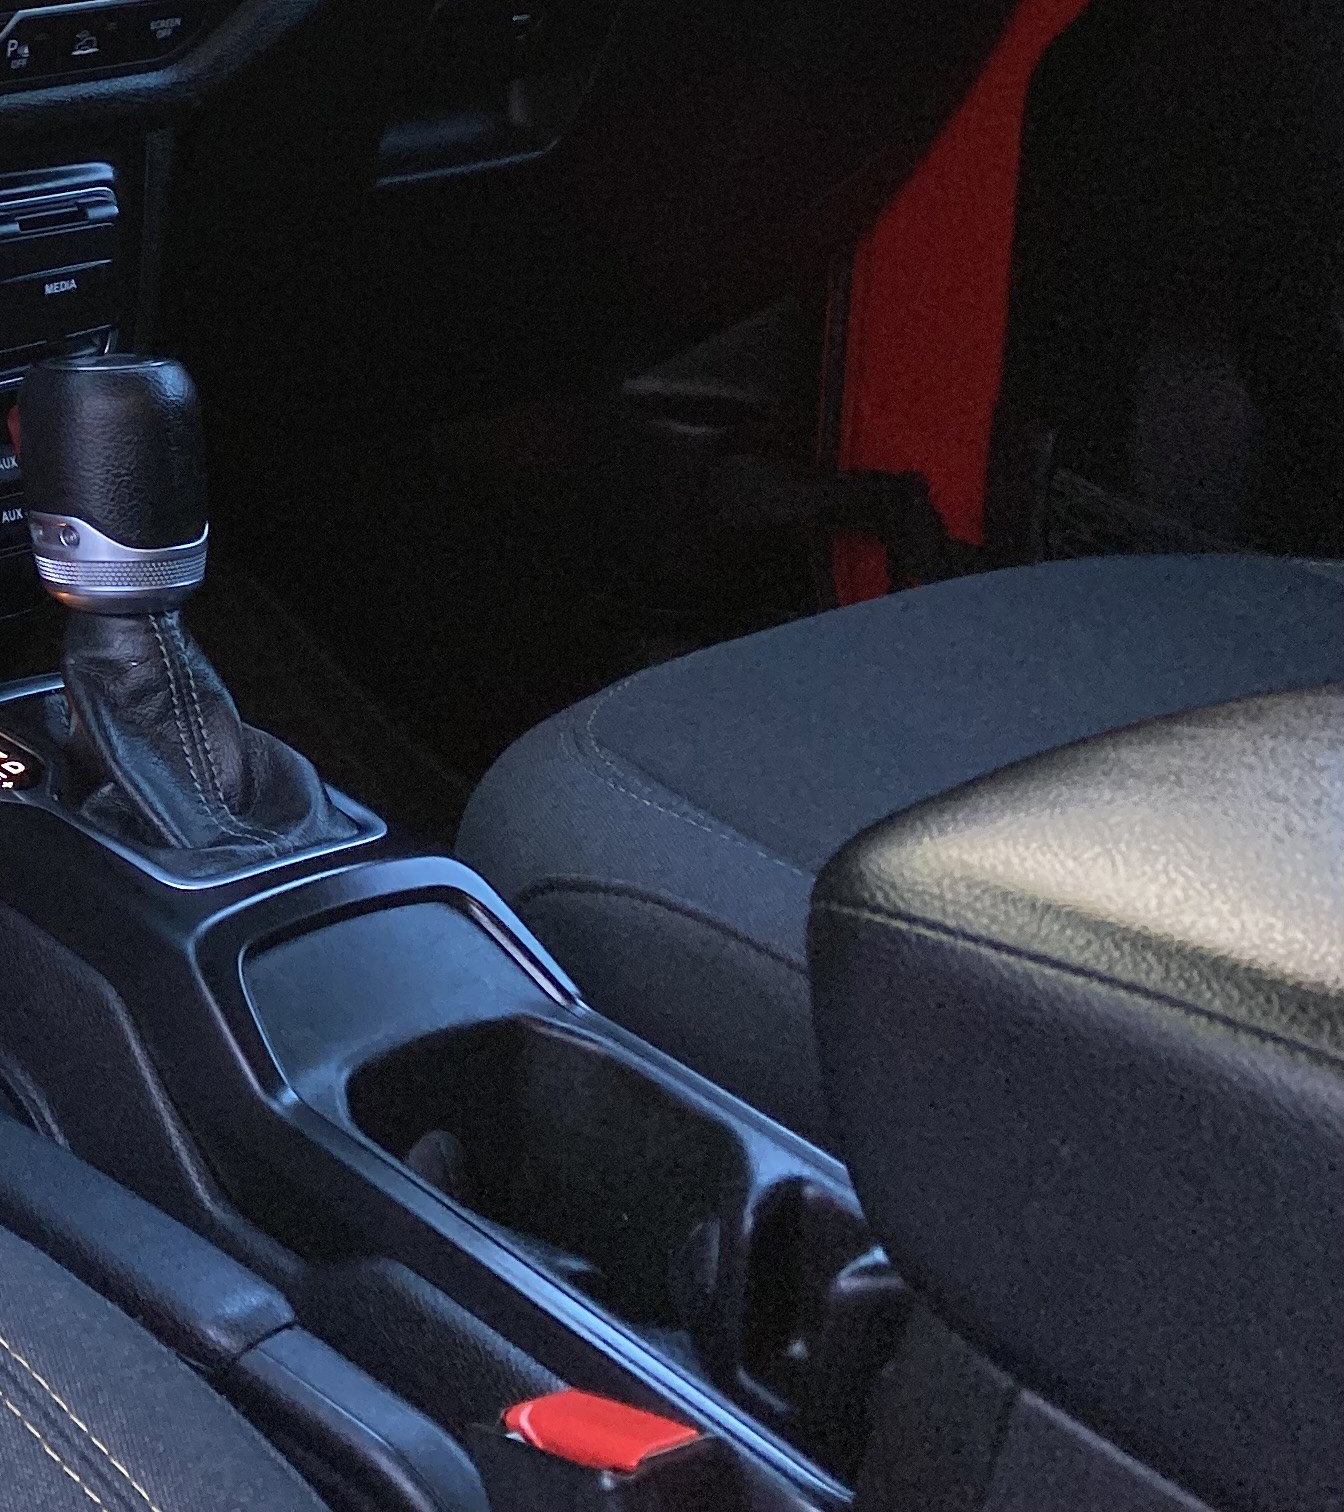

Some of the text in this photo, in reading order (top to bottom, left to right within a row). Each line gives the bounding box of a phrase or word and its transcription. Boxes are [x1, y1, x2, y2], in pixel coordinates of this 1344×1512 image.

[44, 279, 77, 295] MEDIA
[2, 508, 23, 524] AUX
[0, 761, 26, 775] D
